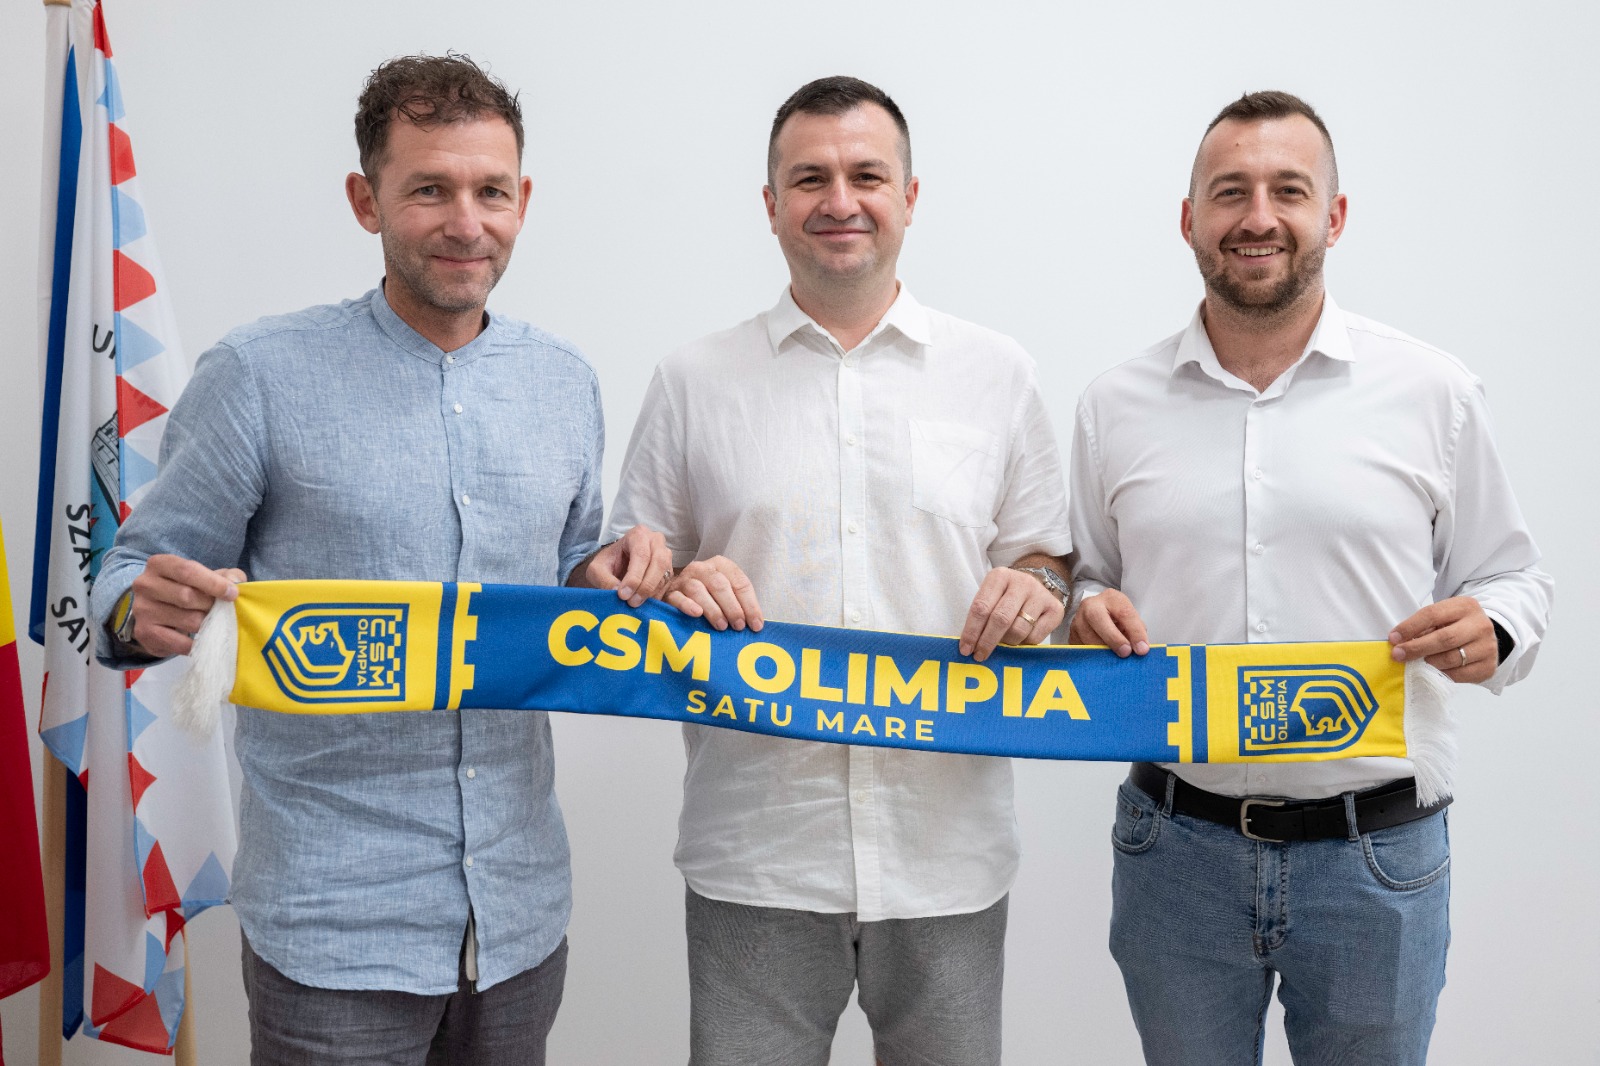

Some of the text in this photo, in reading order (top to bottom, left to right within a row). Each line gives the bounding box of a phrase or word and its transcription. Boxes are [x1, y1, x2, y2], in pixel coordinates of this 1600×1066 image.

[65, 503, 92, 597] SZA
[50, 596, 90, 667] SAT
[357, 618, 368, 686] OLIMPIA
[369, 618, 386, 686] CSM
[547, 610, 1091, 721] CSM OLIMPIA
[686, 690, 935, 742] SATU MARE
[1260, 679, 1275, 742] CSM
[1278, 680, 1288, 741] OLIMPIA
